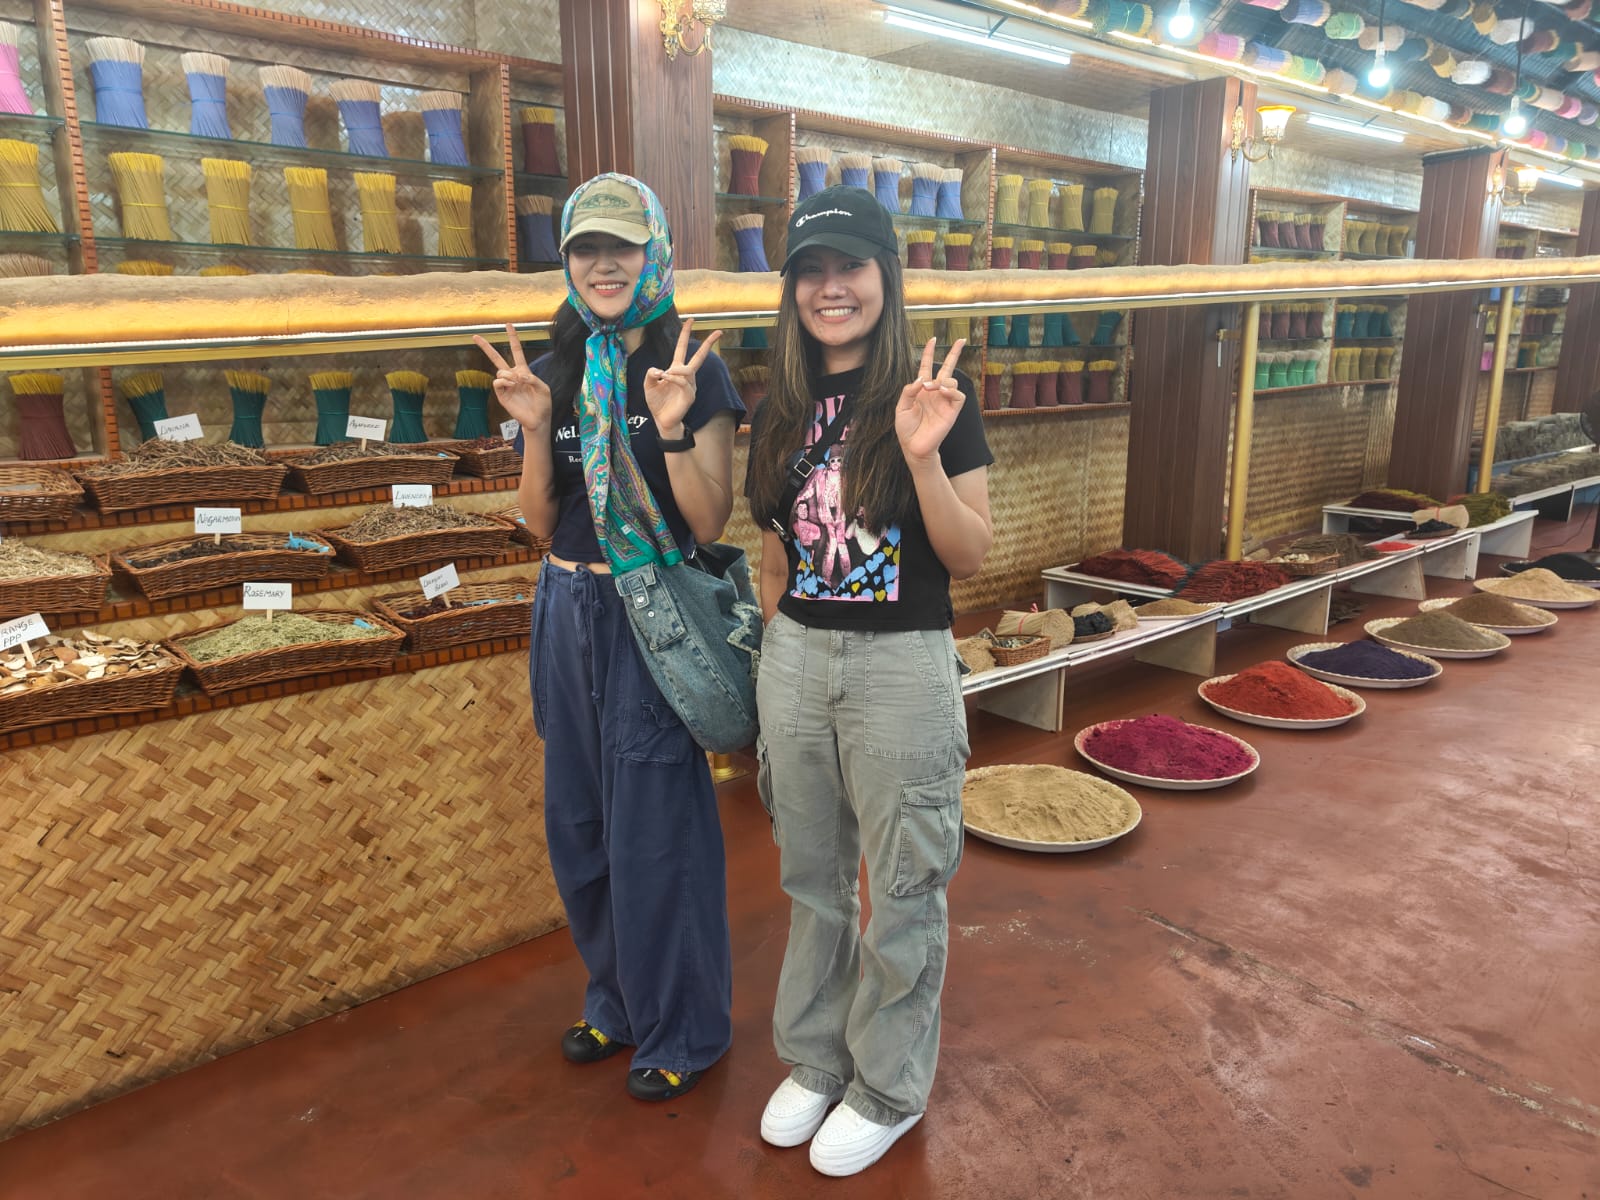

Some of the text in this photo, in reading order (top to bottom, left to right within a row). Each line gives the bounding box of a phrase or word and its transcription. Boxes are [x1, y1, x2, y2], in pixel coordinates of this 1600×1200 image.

[796, 208, 853, 227] Champion
[244, 585, 285, 598] ROSEMARY
[0, 618, 33, 636] RANGE
